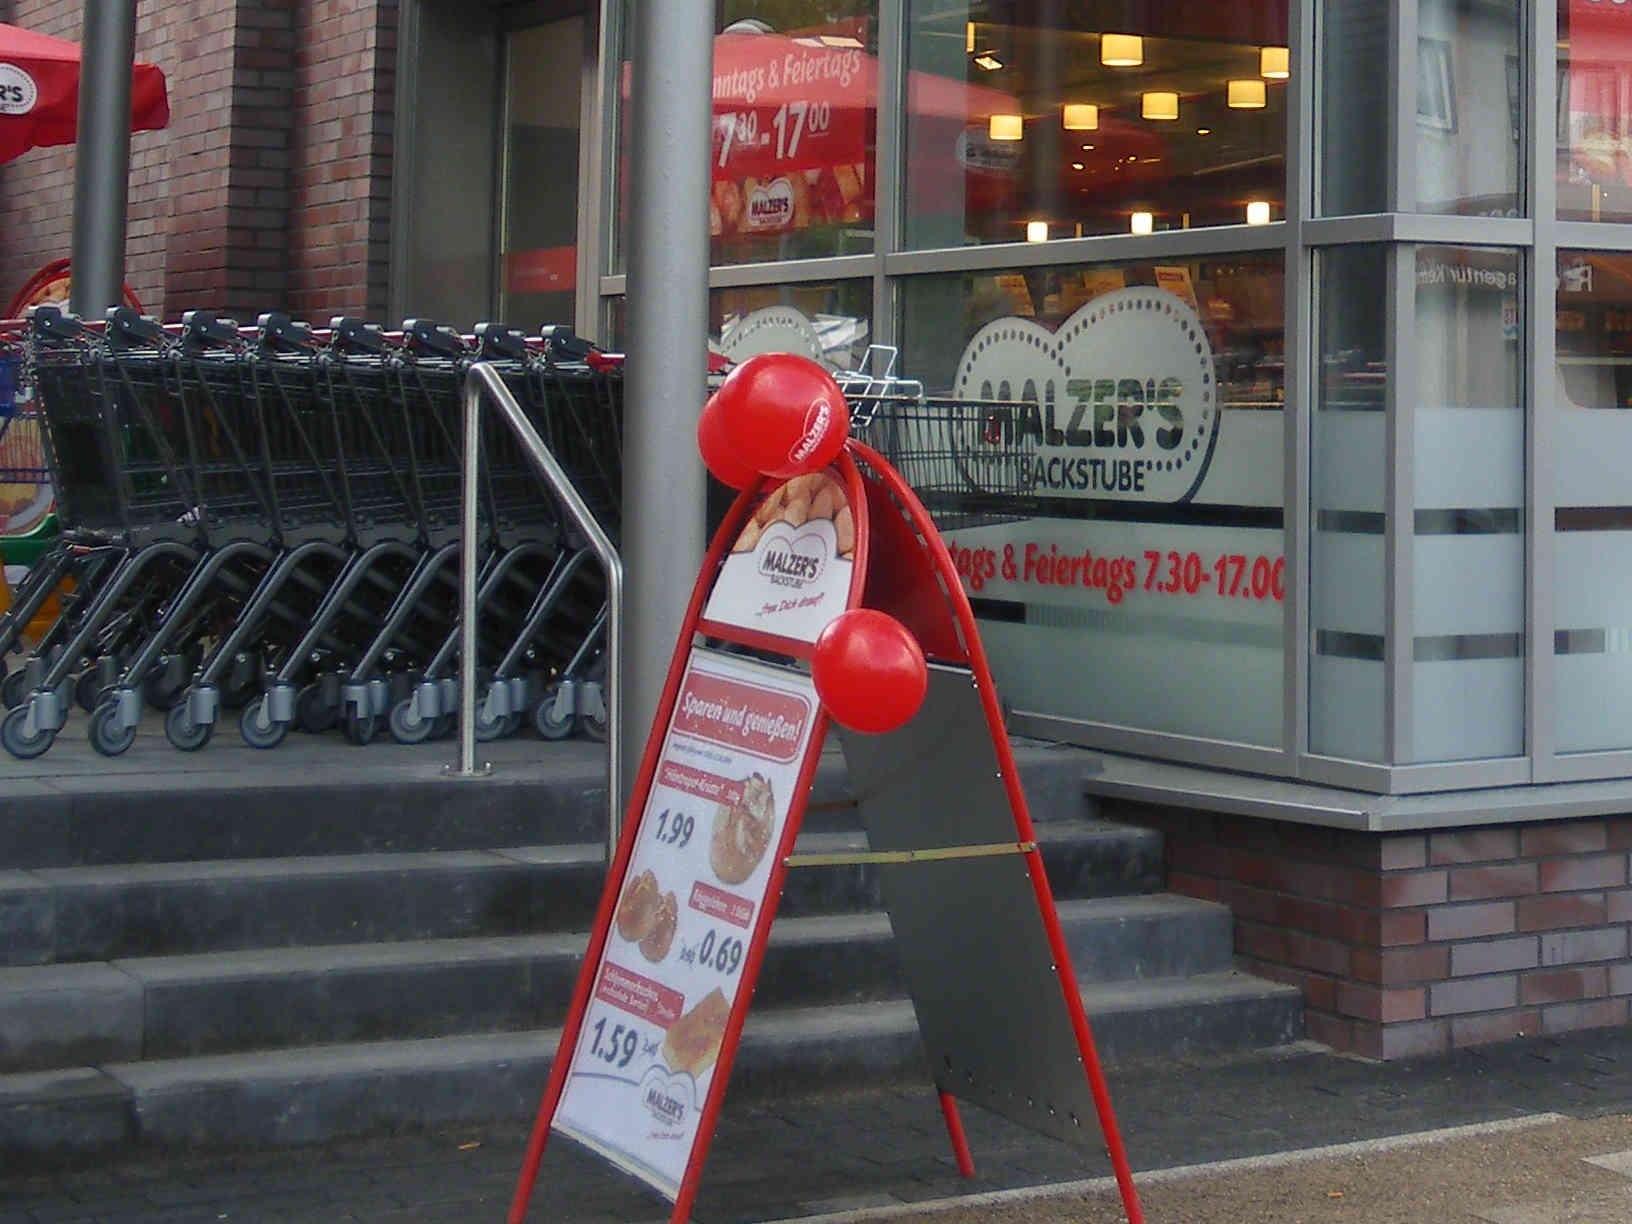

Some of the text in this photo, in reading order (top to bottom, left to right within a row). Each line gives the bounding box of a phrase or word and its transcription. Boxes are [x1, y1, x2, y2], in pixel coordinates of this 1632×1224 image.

[768, 59, 780, 89] &
[783, 49, 861, 88] Feiertags
[751, 197, 789, 217] MALZER'S
[794, 405, 831, 461] MALZER'S
[980, 376, 1185, 450] MALZER'S
[1021, 457, 1145, 492] BACKSTUBE
[762, 550, 819, 579] MALZER'S
[1001, 542, 1016, 581] &
[1024, 541, 1136, 604] Feiertags
[682, 691, 801, 743] Sparen und genießen!
[656, 808, 695, 849] 1.99
[699, 929, 743, 976] 0.69
[590, 1016, 639, 1069] 1.59
[646, 1087, 685, 1123] MALZER'S
